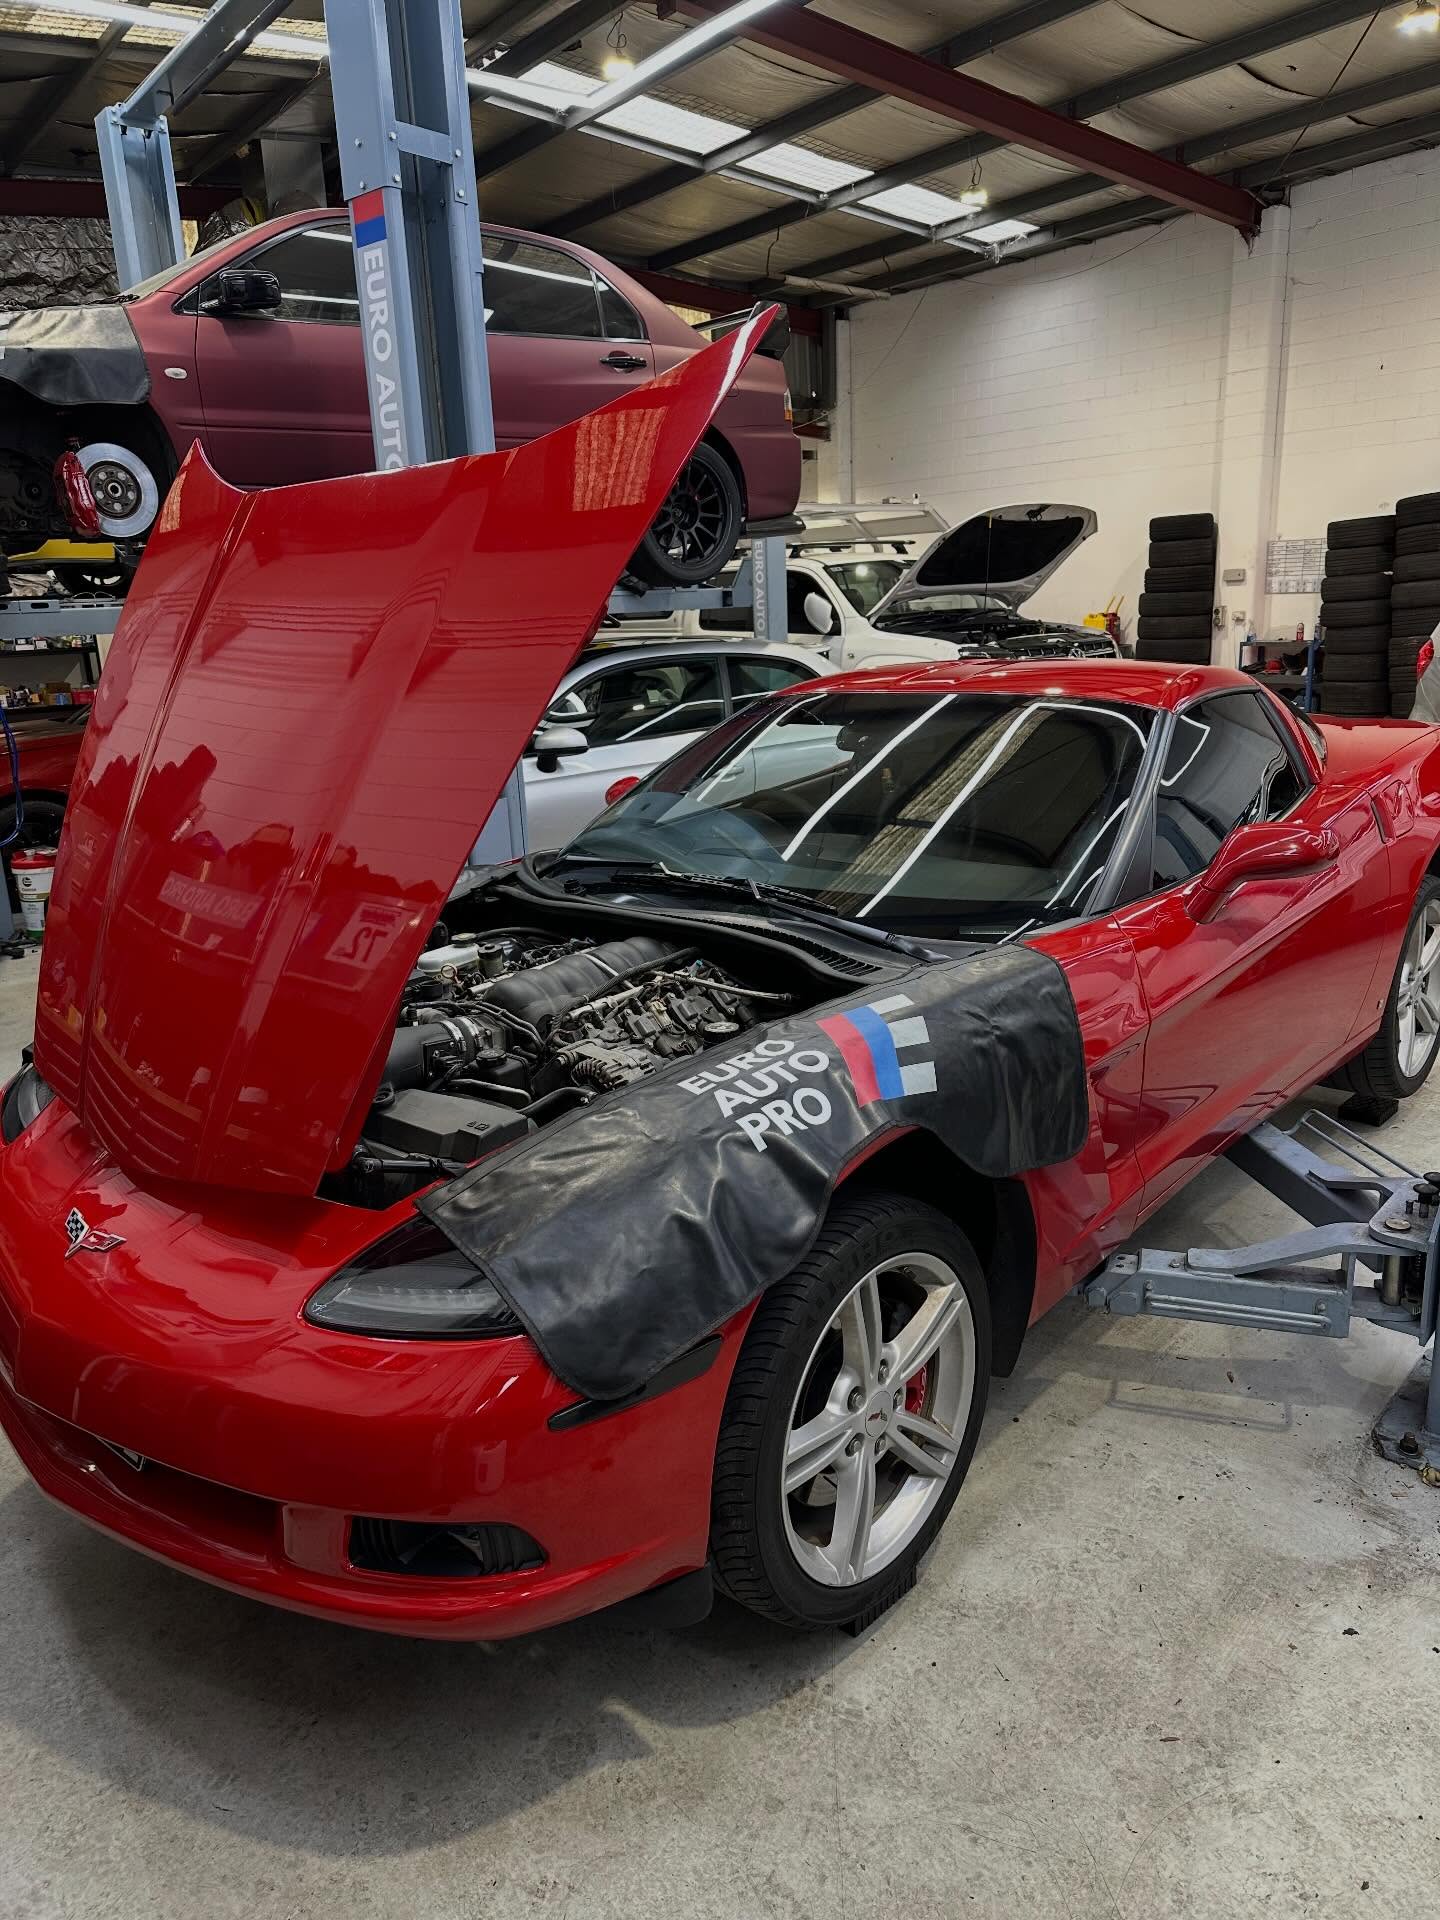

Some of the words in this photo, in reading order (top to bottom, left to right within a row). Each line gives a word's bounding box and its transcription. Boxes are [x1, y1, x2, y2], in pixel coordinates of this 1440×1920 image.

[363, 247, 392, 361] EURO
[754, 541, 764, 583] EURO
[756, 588, 766, 631] AUTO
[676, 1040, 794, 1095] EURO
[713, 1050, 829, 1118] AUTO
[735, 1088, 832, 1152] PRO
